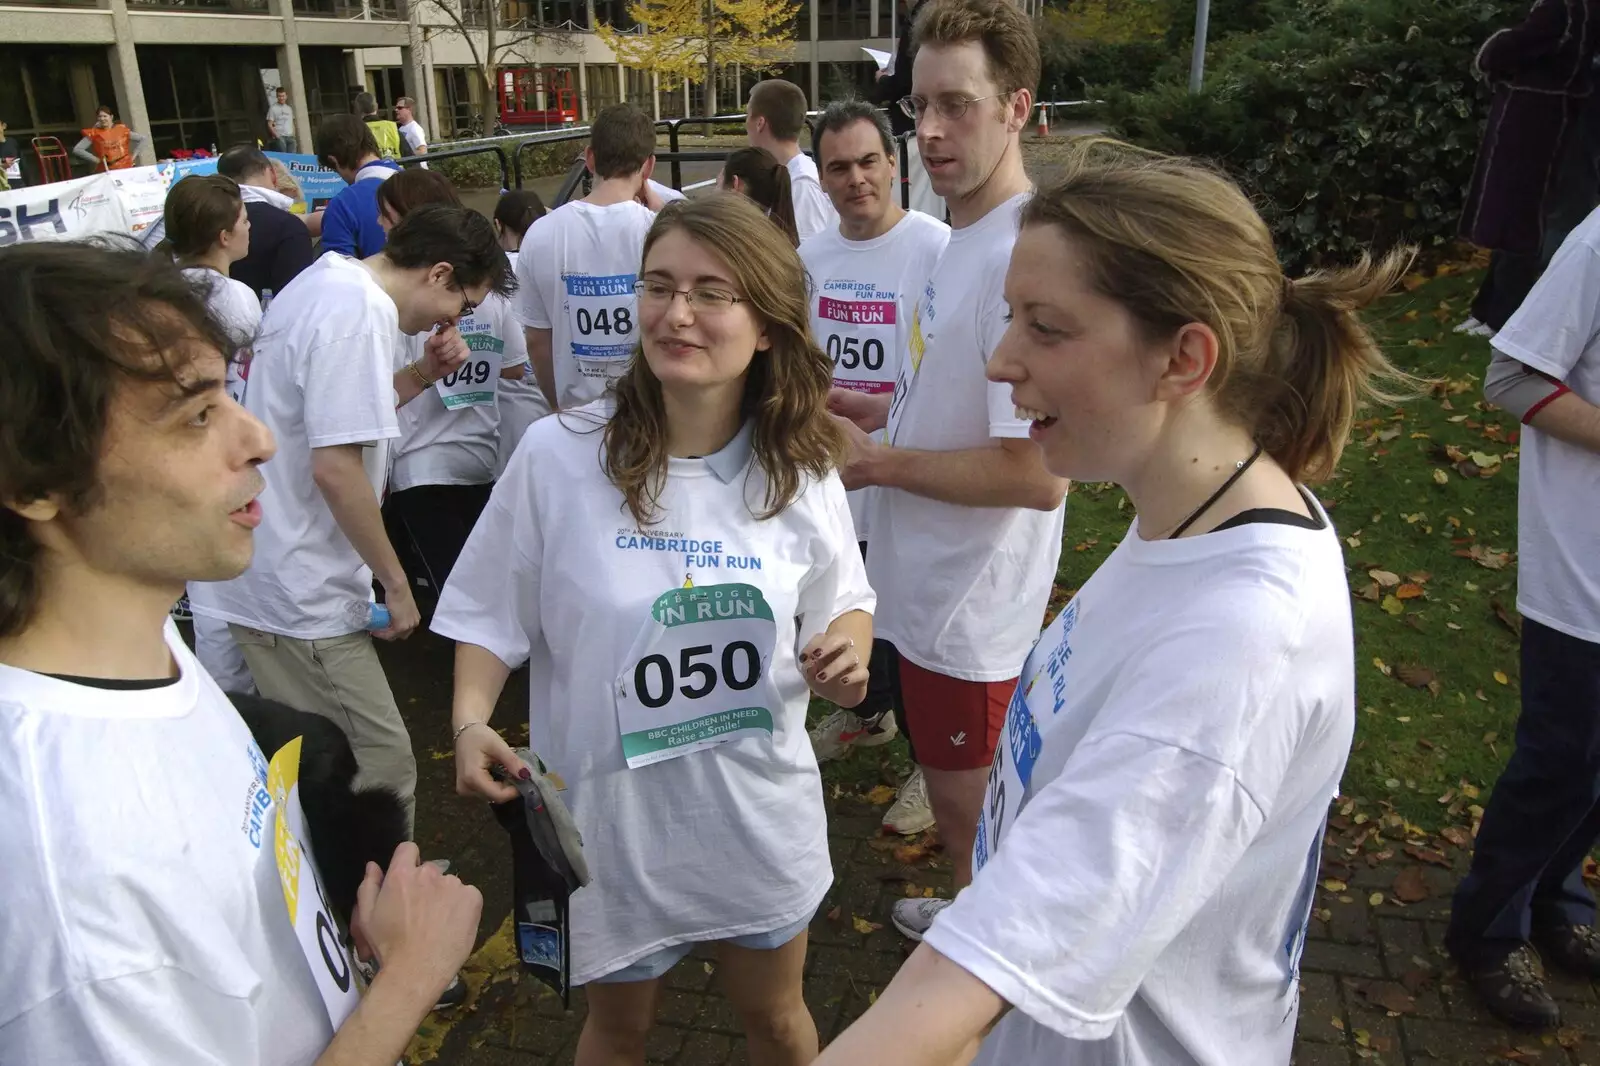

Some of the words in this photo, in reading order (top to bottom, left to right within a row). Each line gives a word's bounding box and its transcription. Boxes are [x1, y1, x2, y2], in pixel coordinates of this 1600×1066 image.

[290, 161, 315, 173] Fun
[573, 285, 595, 295] FUN
[600, 283, 628, 295] RUN
[824, 283, 876, 291] CAMBRIDGE
[856, 291, 873, 299] FUN
[576, 307, 632, 336] 048
[828, 307, 848, 320] FUN
[852, 311, 883, 322] RUN
[471, 342, 494, 351] RUN
[826, 333, 884, 371] 050
[615, 536, 723, 553] CAMBRIDGE
[686, 555, 719, 568] FUN
[726, 556, 761, 569] RUN
[697, 599, 755, 619] RUN
[634, 640, 761, 708] 050
[648, 730, 669, 740] BBC
[670, 717, 718, 736] CHILDREN
[720, 714, 730, 722] IN
[733, 709, 759, 720] NEED
[668, 735, 696, 746] Raise
[707, 720, 741, 736] Smile!
